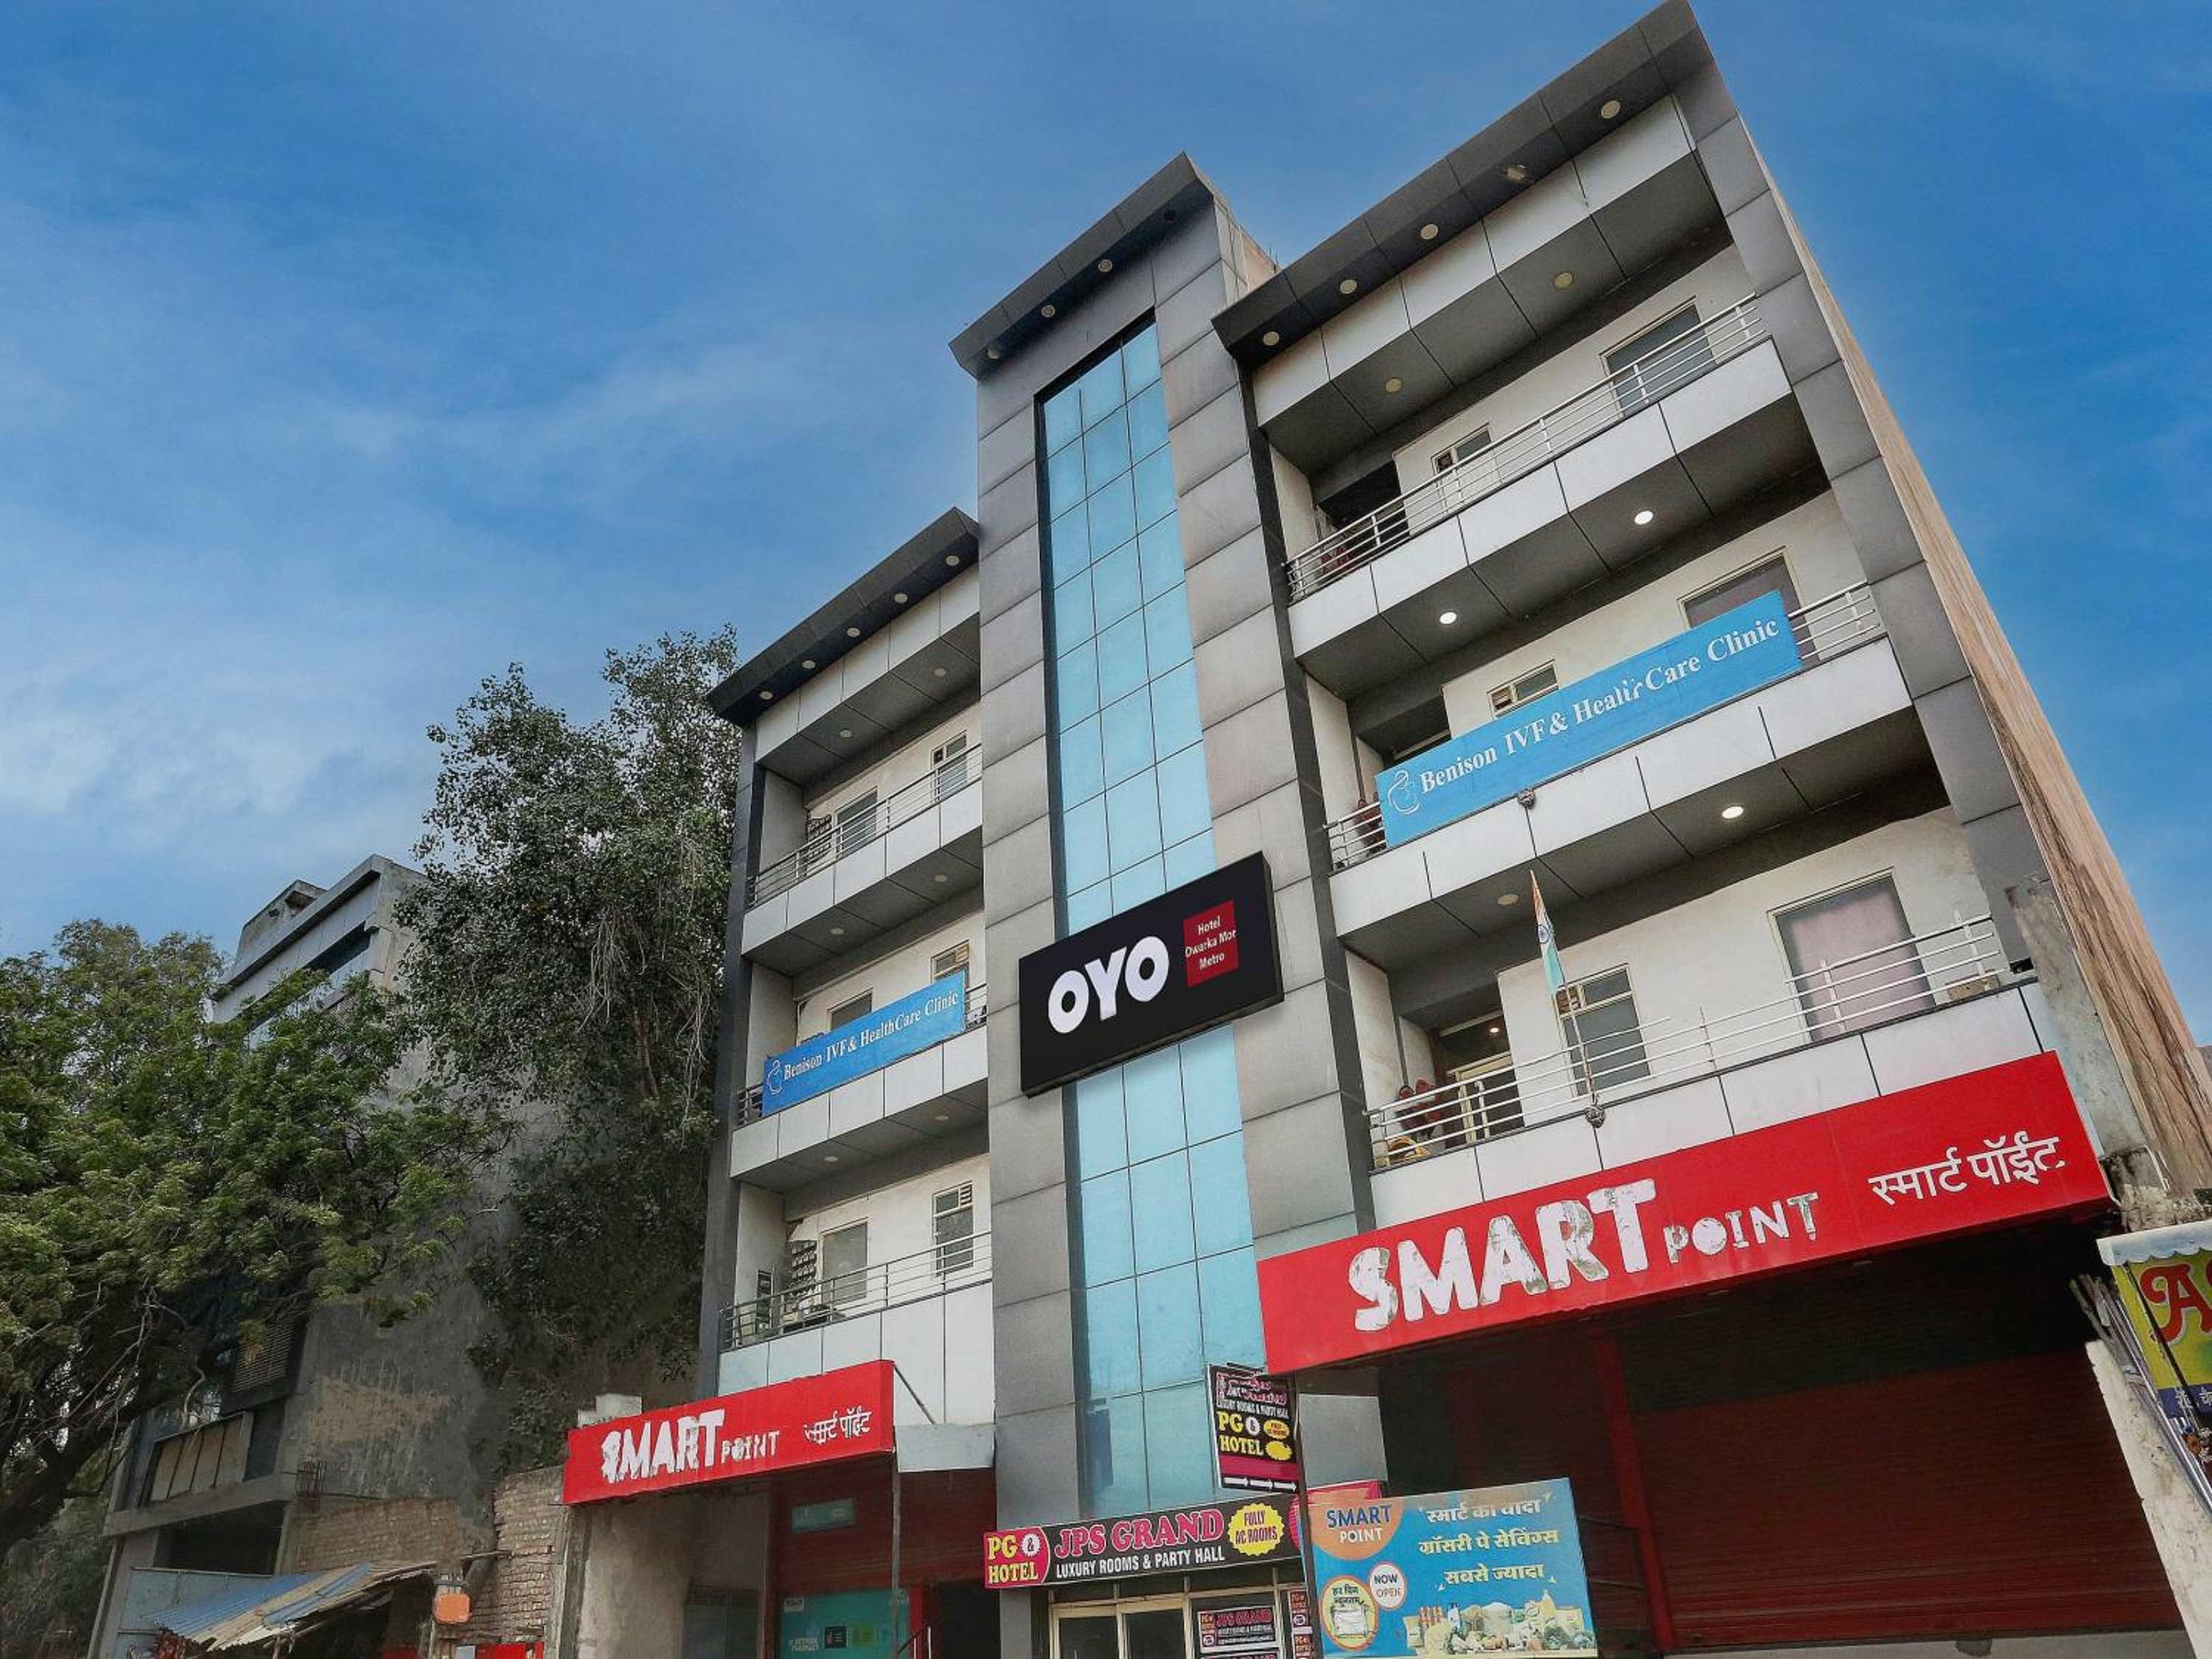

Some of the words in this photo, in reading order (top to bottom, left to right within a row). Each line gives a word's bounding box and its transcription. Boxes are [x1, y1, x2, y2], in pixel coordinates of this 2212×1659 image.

[1420, 746, 1497, 794] Benison
[1504, 718, 1545, 757] IVF
[1548, 712, 1568, 736] &
[1707, 618, 1779, 662] Clinic
[1198, 915, 1220, 935] Hotel
[1185, 937, 1217, 958] Dwarka
[1219, 929, 1237, 944] Mor
[1200, 953, 1225, 970] Metro
[1048, 936, 1170, 1034] OYO
[784, 1054, 822, 1080] Benison
[826, 1040, 847, 1062] IVF
[847, 1037, 857, 1052] &
[925, 991, 959, 1017] Clinic
[1868, 1147, 1967, 1206] स्मार्ट
[1349, 1178, 1656, 1332] SMART
[1663, 1192, 1818, 1264] POINT
[1217, 1411, 1244, 1433] PG
[601, 1408, 725, 1485] SMART
[721, 1430, 780, 1464] POINT
[1220, 1436, 1264, 1455] HOTEL
[1245, 1510, 1265, 1526] FULLY
[1327, 1504, 1392, 1528] SMART
[1055, 1525, 1106, 1558] JPS
[1111, 1509, 1225, 1551] GRAND
[1236, 1529, 1247, 1545] AC
[1248, 1526, 1278, 1543] ROOMS
[1340, 1528, 1382, 1543] POINT
[987, 1534, 1018, 1560] PG
[988, 1561, 1038, 1585] HOTEL
[1056, 1562, 1096, 1579] LUXURY
[1099, 1557, 1138, 1574] ROOMS
[1142, 1554, 1151, 1570] &
[1155, 1549, 1192, 1568] PARTY
[1194, 1545, 1225, 1563] HALL
[1444, 1562, 1489, 1585] सबसे
[1374, 1573, 1398, 1585] NOW
[1376, 1587, 1401, 1599] OPEN
